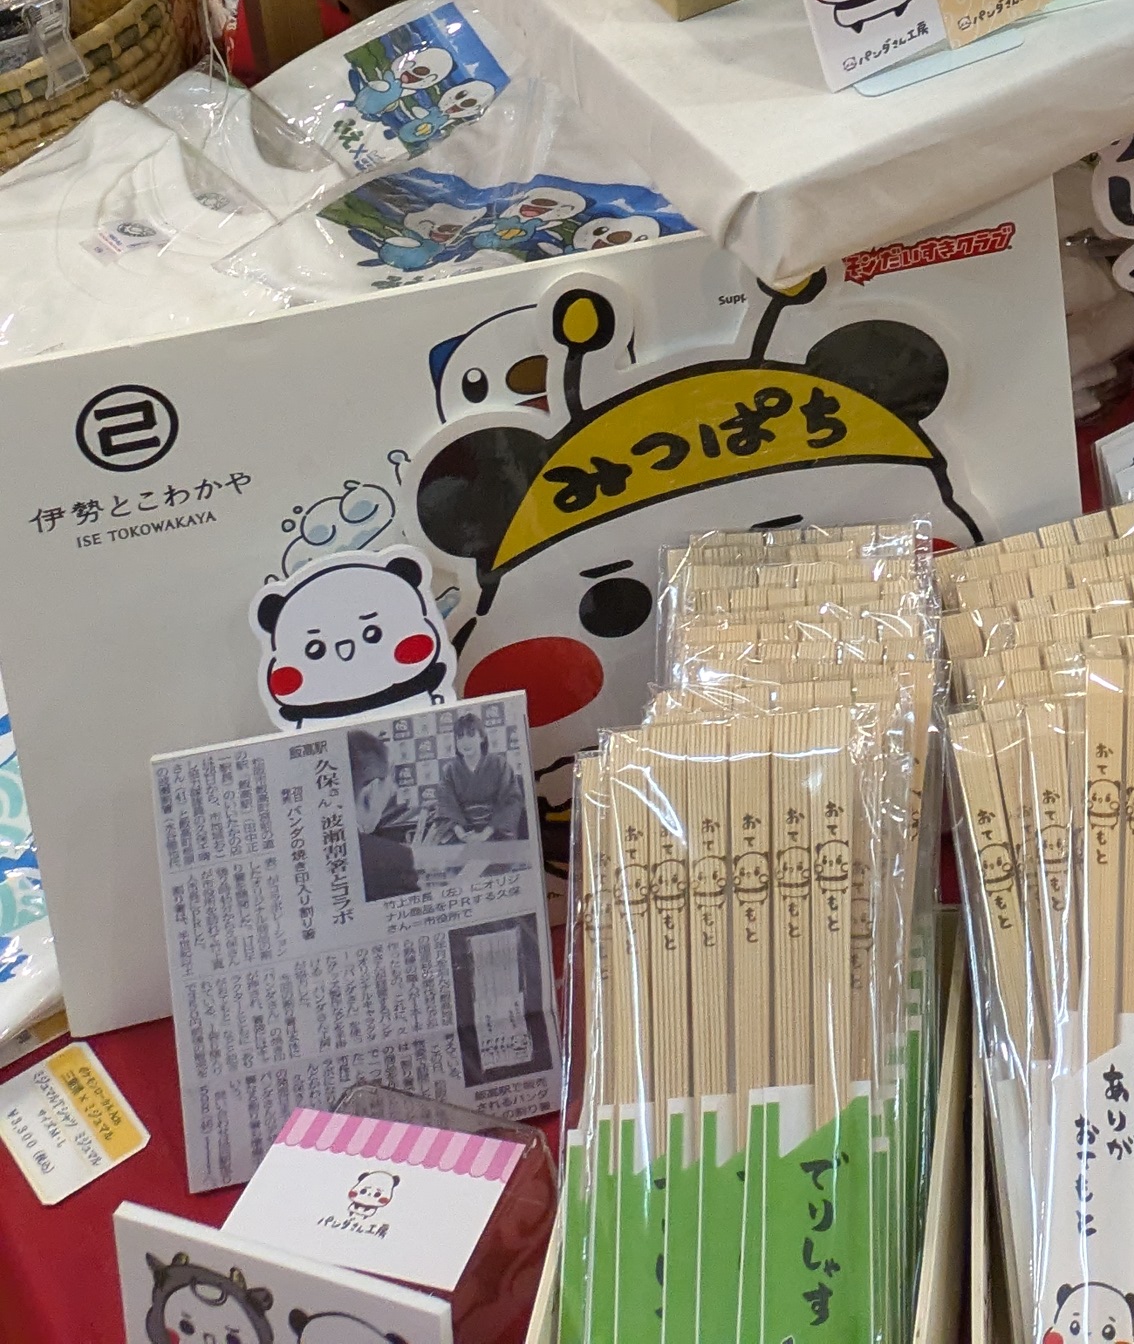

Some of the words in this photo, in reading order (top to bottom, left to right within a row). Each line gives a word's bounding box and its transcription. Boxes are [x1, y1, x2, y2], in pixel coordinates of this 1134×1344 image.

[858, 21, 930, 65] パンダさん工房
[541, 387, 848, 516] みつぱち
[29, 469, 254, 536] 伊勢とこわかや
[75, 529, 105, 549] ISE
[107, 509, 218, 545] TOKOWAKAYA
[801, 1153, 852, 1326] でりしゃす
